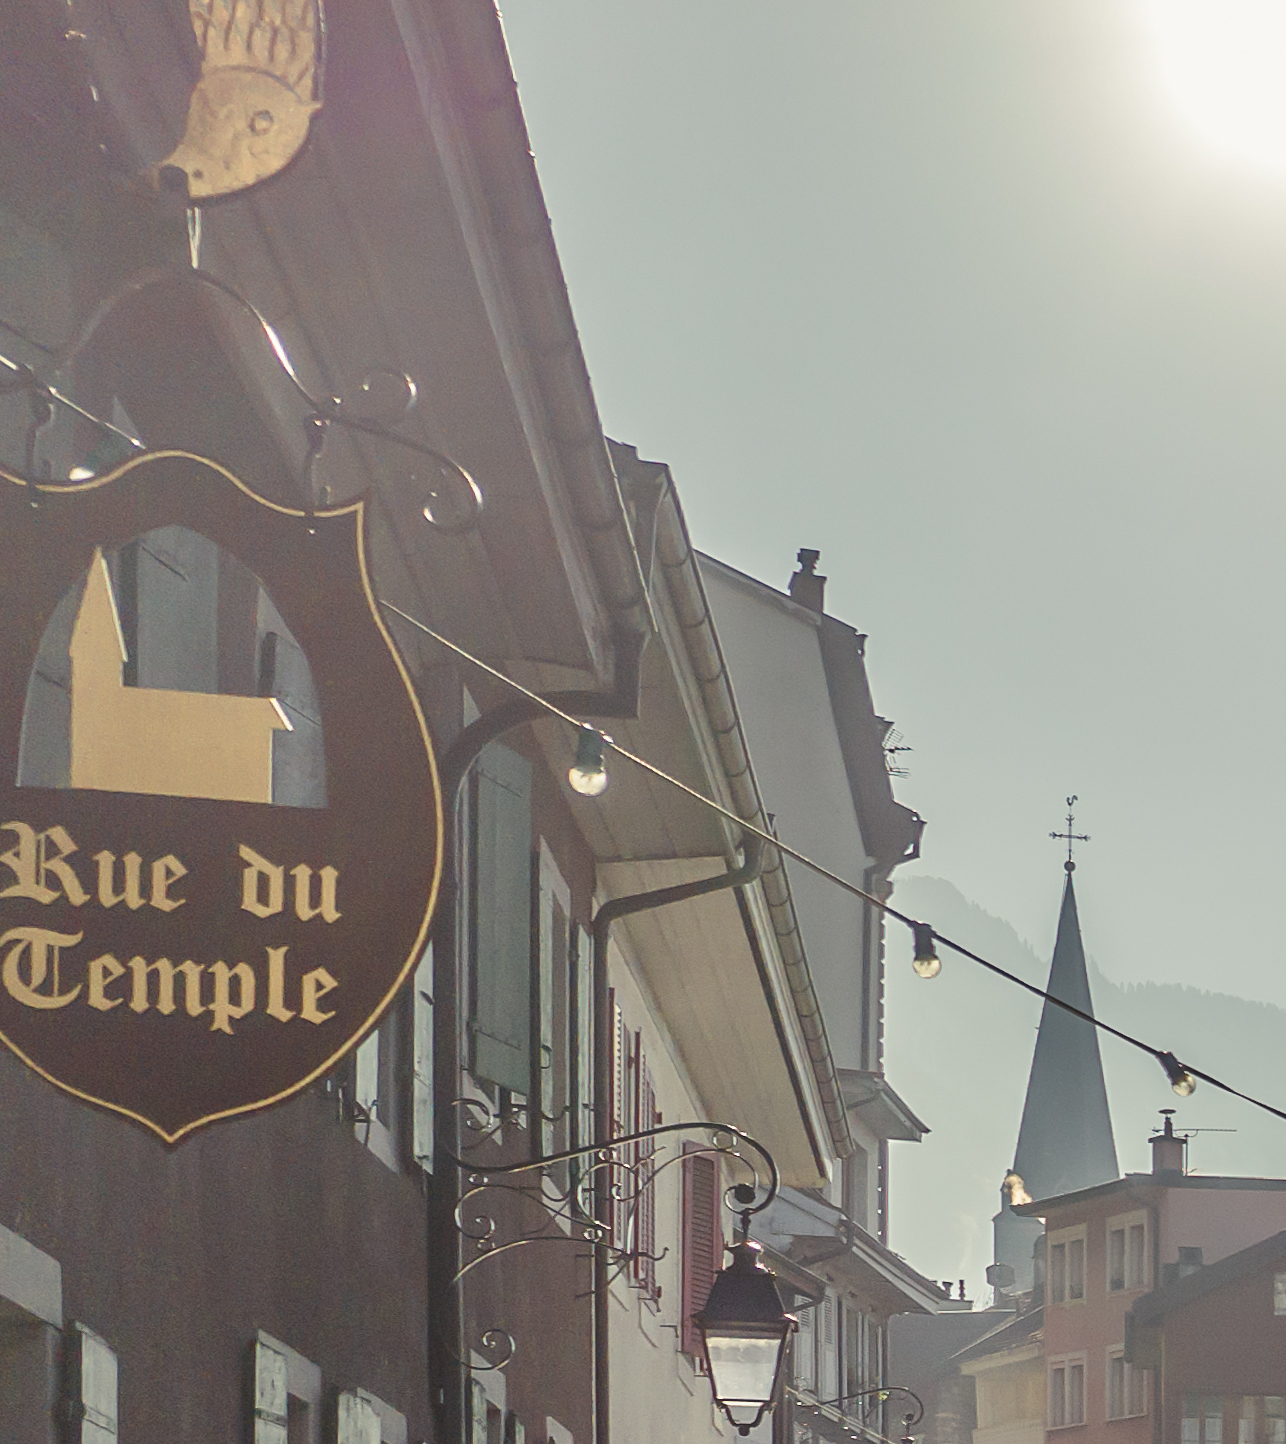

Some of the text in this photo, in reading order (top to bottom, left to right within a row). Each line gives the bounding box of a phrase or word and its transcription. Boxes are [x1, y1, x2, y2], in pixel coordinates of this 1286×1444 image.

[0, 820, 342, 924] Rue du
[0, 926, 339, 1035] Temple
